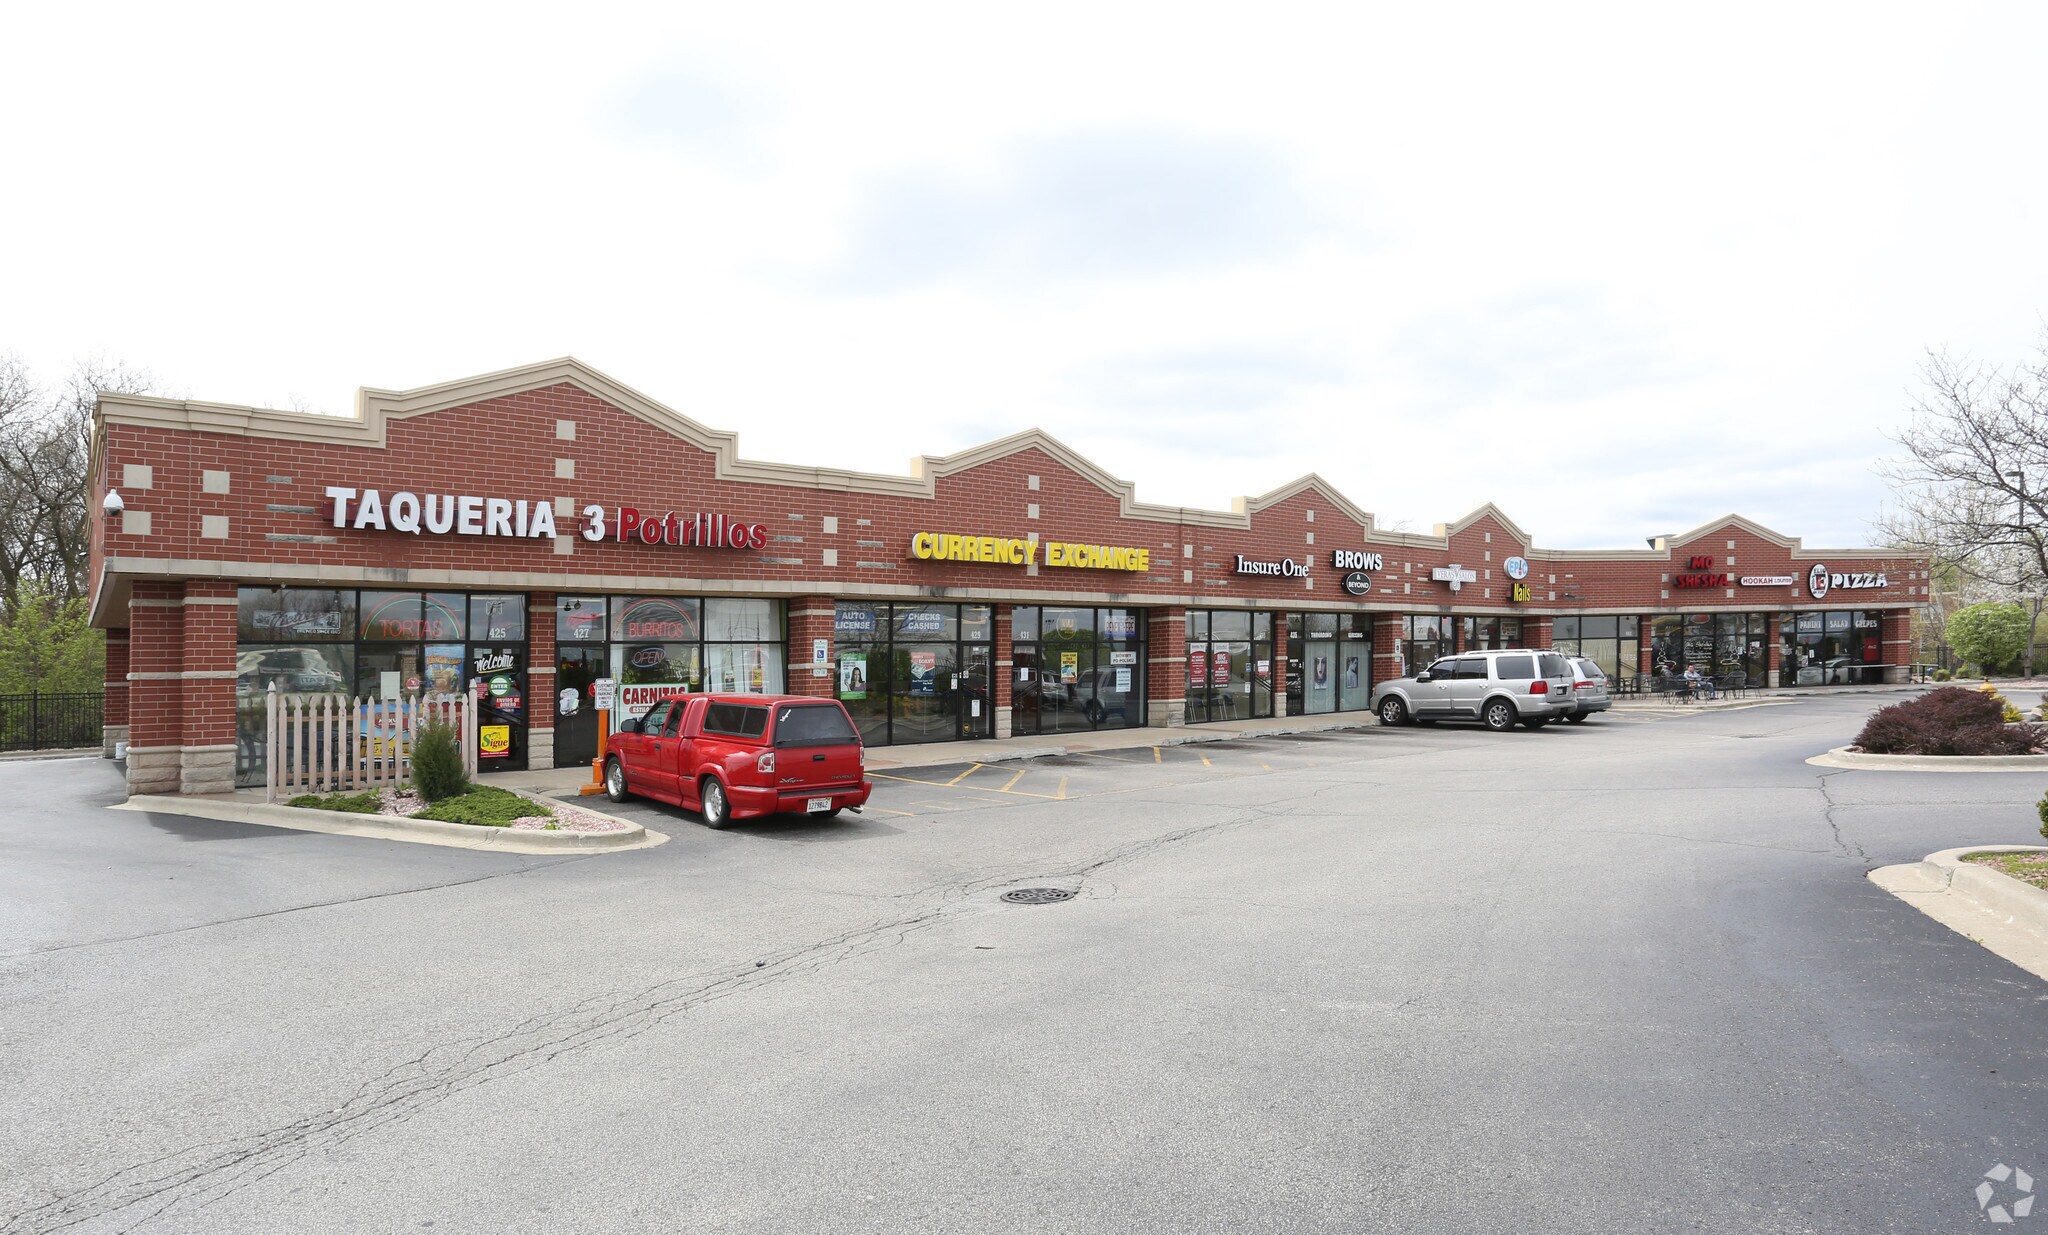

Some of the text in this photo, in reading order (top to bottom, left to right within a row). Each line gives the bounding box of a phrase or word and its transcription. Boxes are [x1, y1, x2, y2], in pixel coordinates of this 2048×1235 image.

[325, 486, 768, 550] TAQUERIA 3 Potrillos
[912, 531, 1149, 571] CURRENCY EXCHANGE
[1237, 554, 1310, 577] Insure One
[1335, 550, 1383, 571] BROWS
[1691, 556, 1714, 569] MO
[1348, 581, 1369, 589] BEYOND
[1677, 574, 1728, 588] SHESHA
[1742, 577, 1773, 585] HOOKAH
[1831, 573, 1888, 589] PIZZA
[1513, 583, 1530, 602] Nails
[842, 612, 866, 620] AUTO
[908, 613, 941, 621] CHECKS
[379, 619, 444, 638] TORTAS
[629, 621, 684, 638] BURRITOS
[835, 621, 871, 629] LICENSE
[908, 622, 940, 630] CASHED
[489, 628, 506, 638] 425
[574, 628, 589, 638] 427
[474, 654, 515, 672] Welcome
[633, 651, 664, 664] OPEN
[481, 733, 508, 749] Sigue
